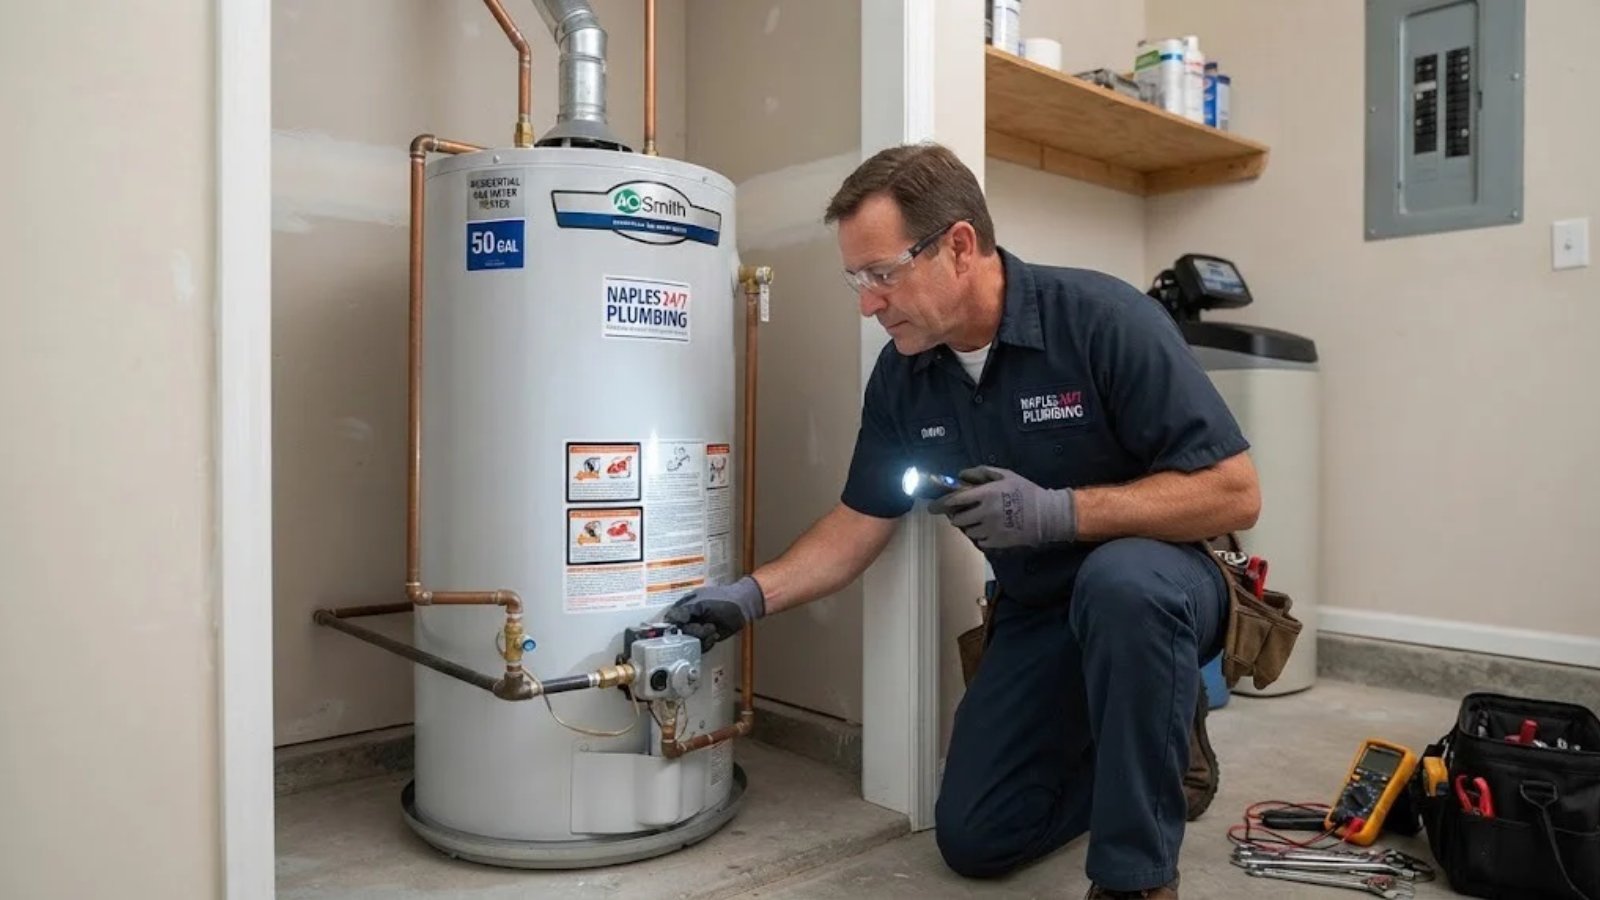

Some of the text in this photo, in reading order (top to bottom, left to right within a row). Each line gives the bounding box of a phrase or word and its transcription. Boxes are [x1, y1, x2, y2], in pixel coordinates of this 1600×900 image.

[642, 196, 686, 218] Smith
[472, 231, 519, 254] 50 GAL
[607, 286, 688, 309] NAPLES 24/7
[607, 304, 688, 328] PLUMBING
